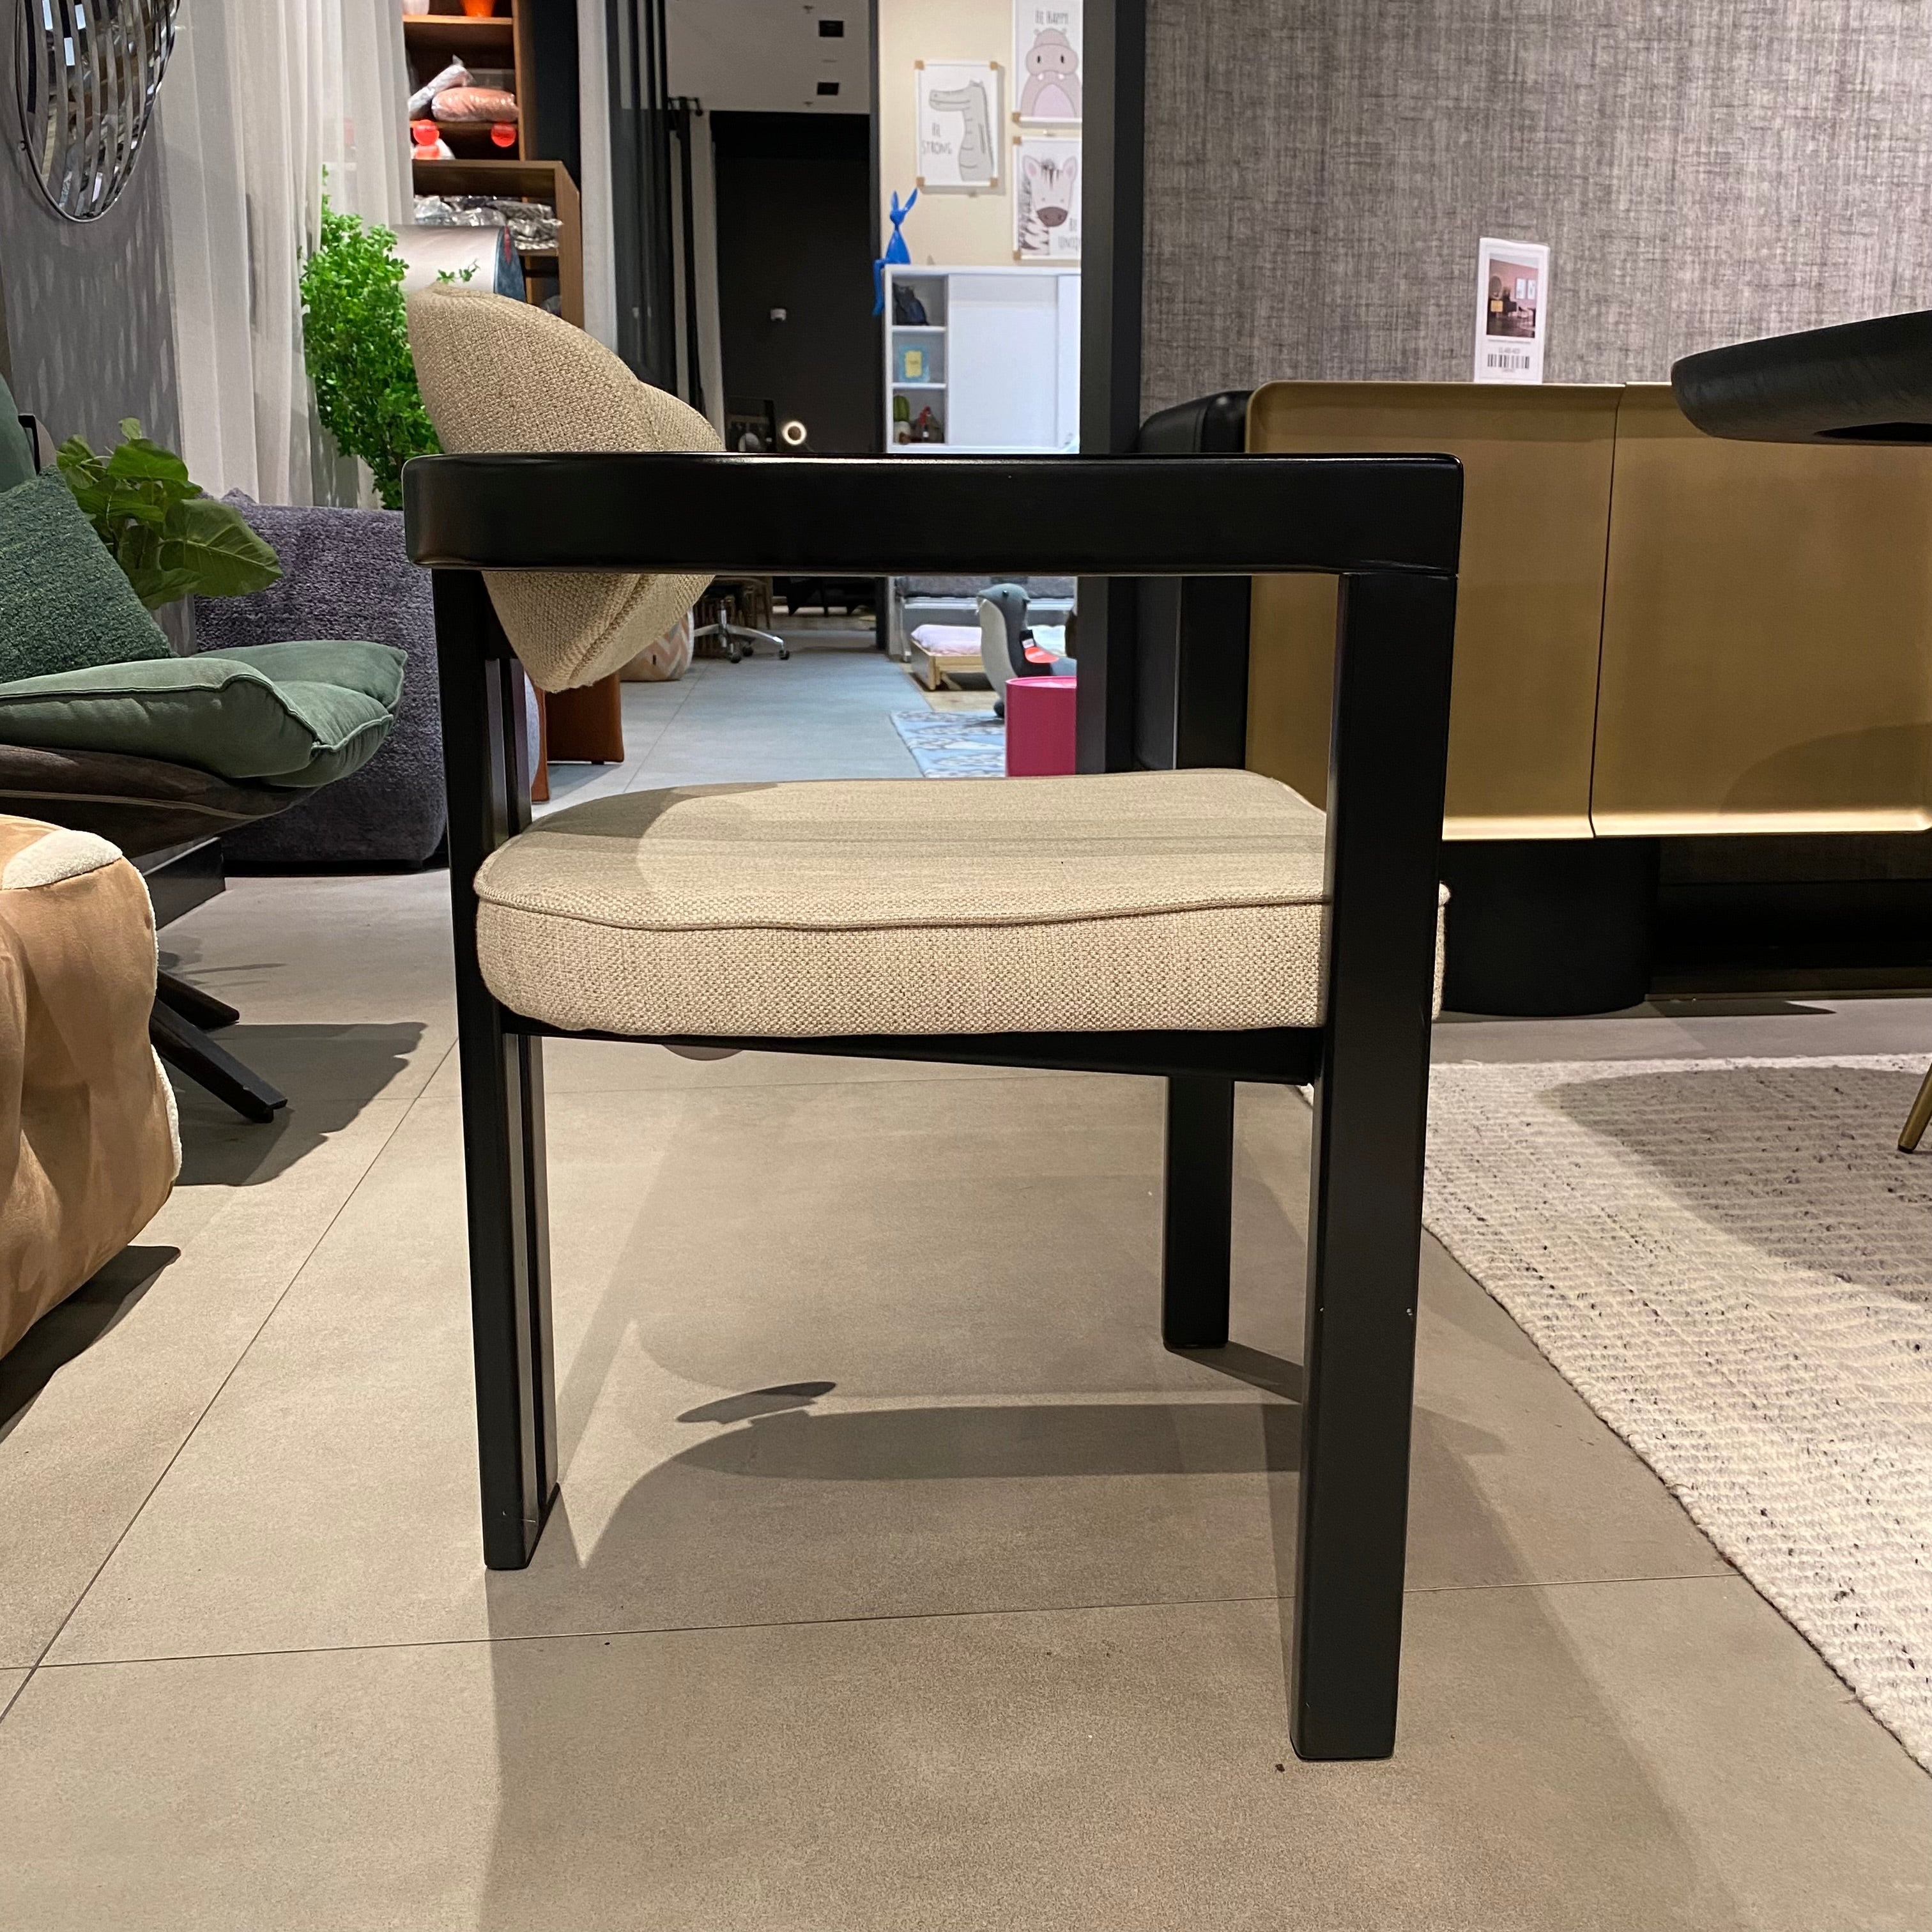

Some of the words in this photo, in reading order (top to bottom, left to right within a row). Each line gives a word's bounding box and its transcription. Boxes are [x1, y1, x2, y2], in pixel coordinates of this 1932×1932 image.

[1035, 10, 1043, 24] BE
[1046, 10, 1069, 25] HAPPY
[931, 122, 940, 137] BE
[921, 140, 952, 155] STRONG
